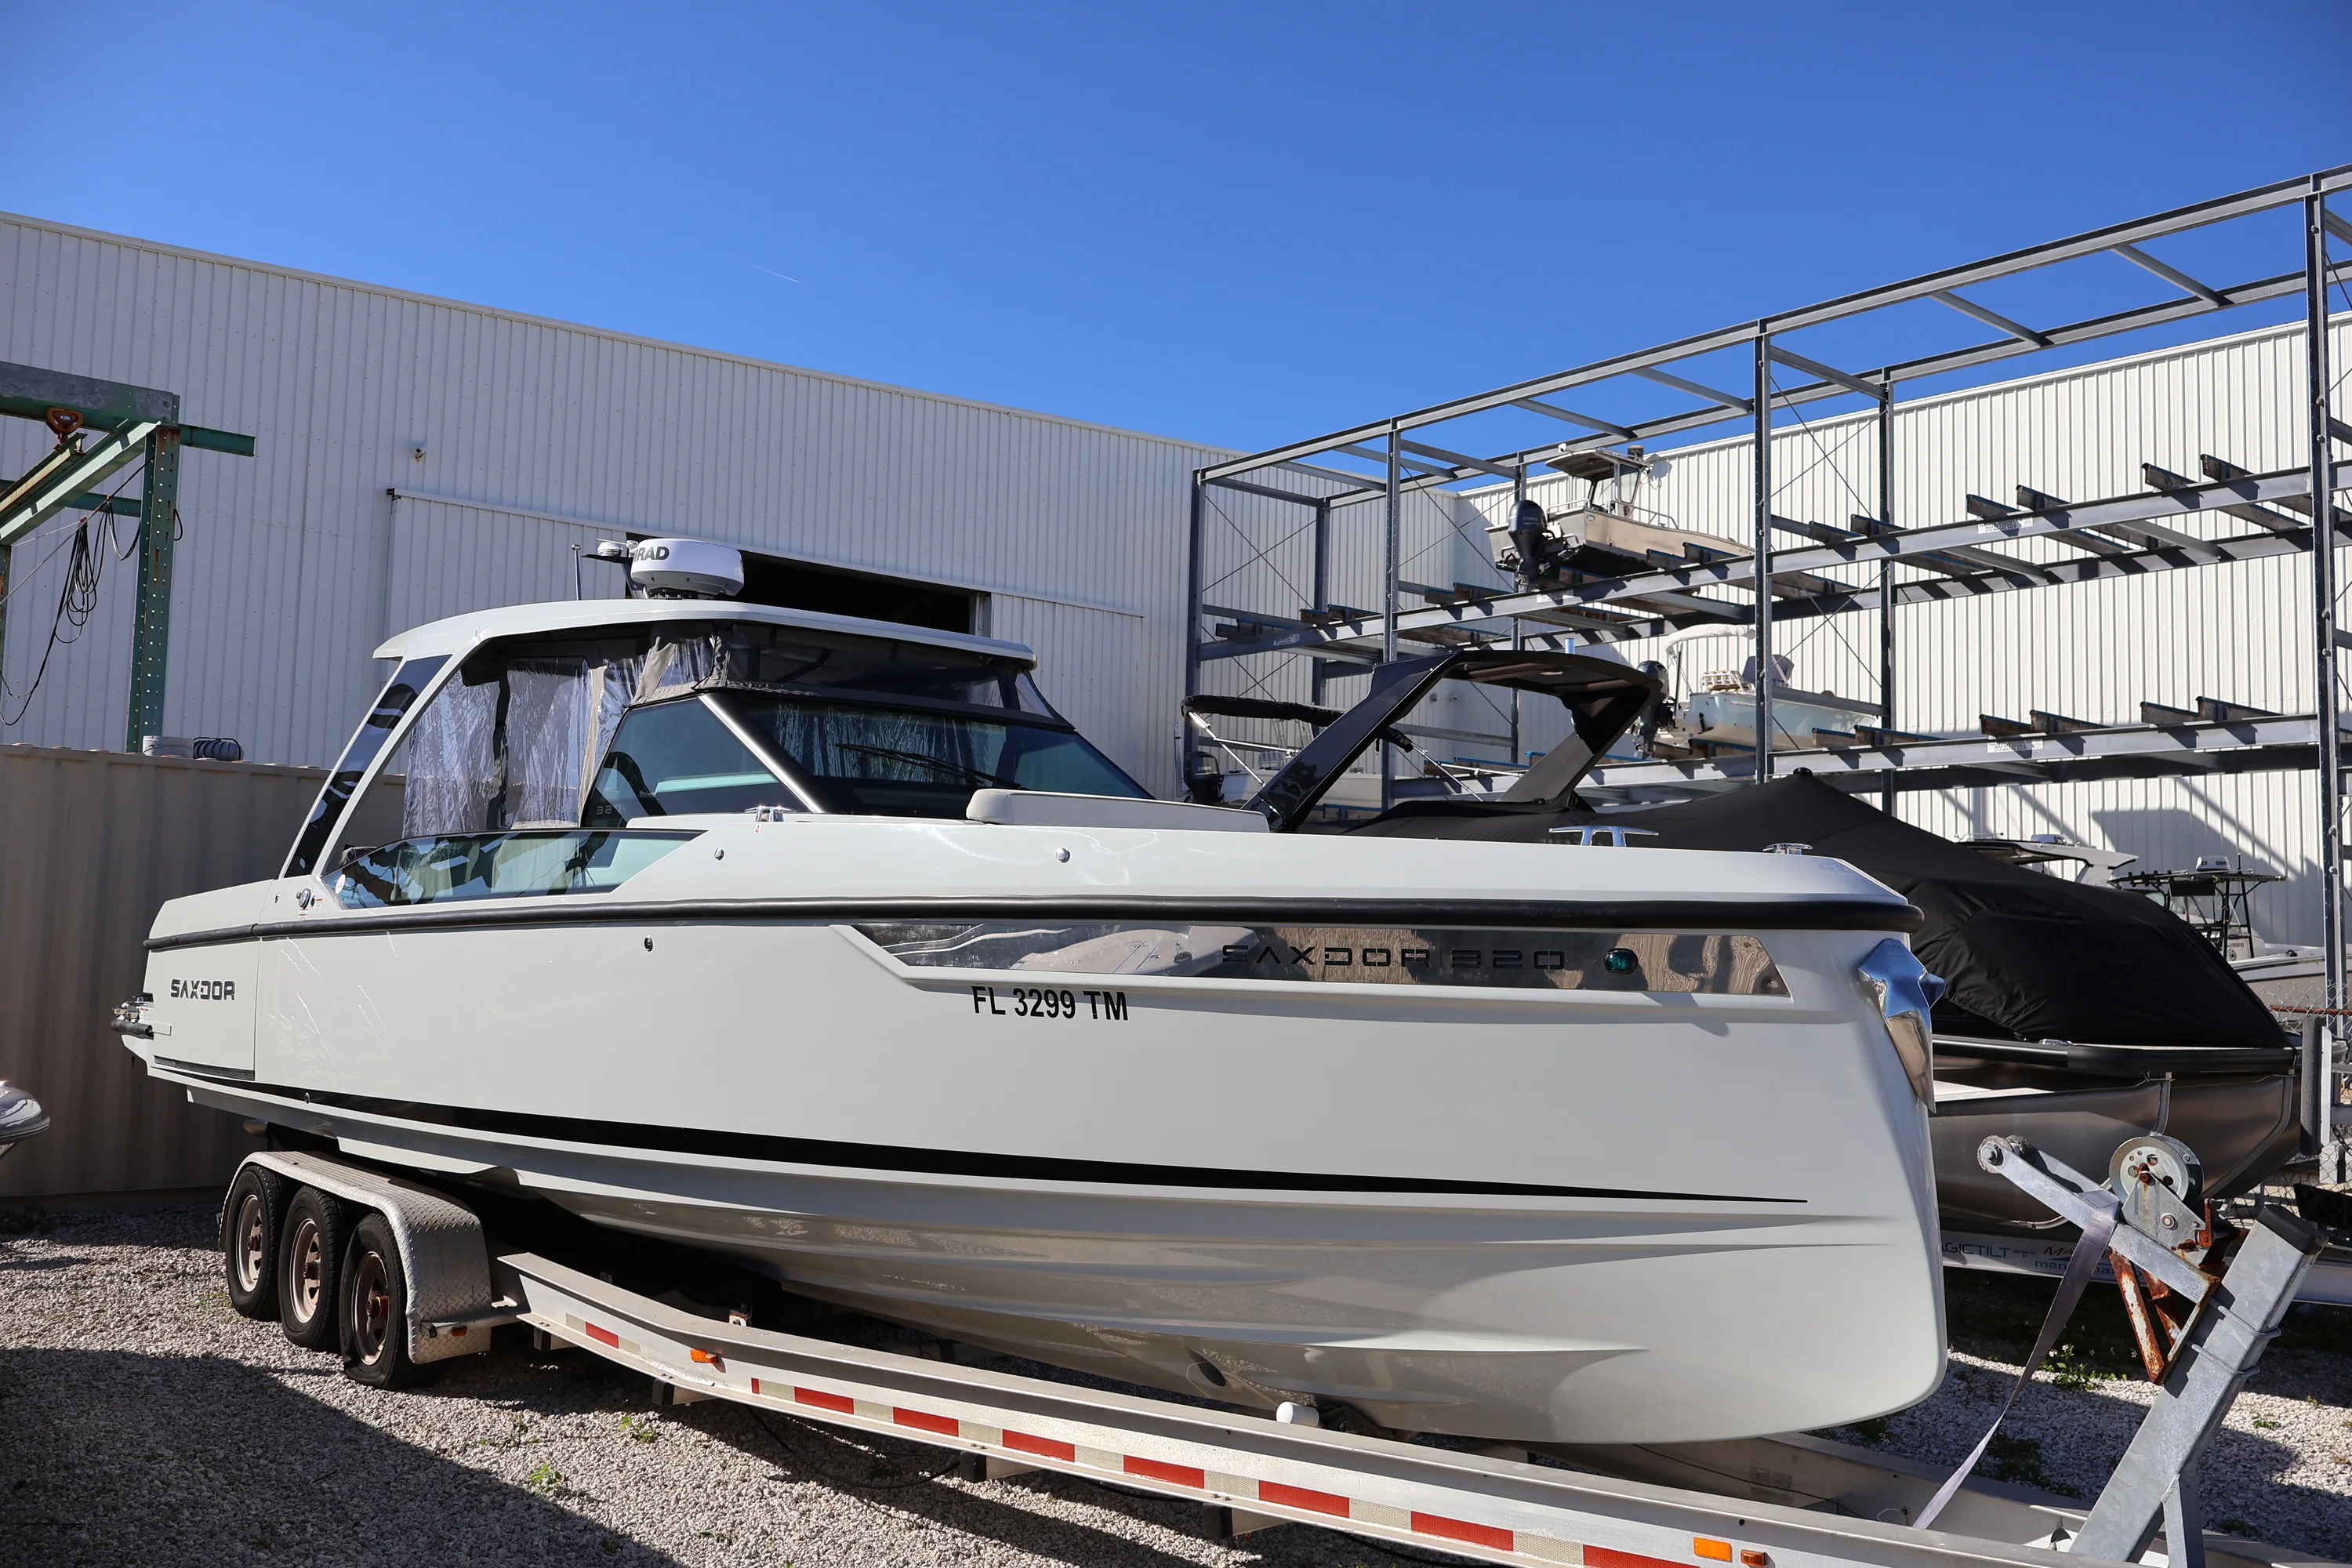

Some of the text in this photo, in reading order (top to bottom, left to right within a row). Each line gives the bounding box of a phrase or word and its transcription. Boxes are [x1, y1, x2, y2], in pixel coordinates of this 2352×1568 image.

[1222, 945, 1565, 970] SAXDOR 320
[170, 978, 235, 1000] SAXDOR
[971, 985, 1128, 1021] FL 3299 TM
[1941, 1242, 2011, 1258] GICTILT
